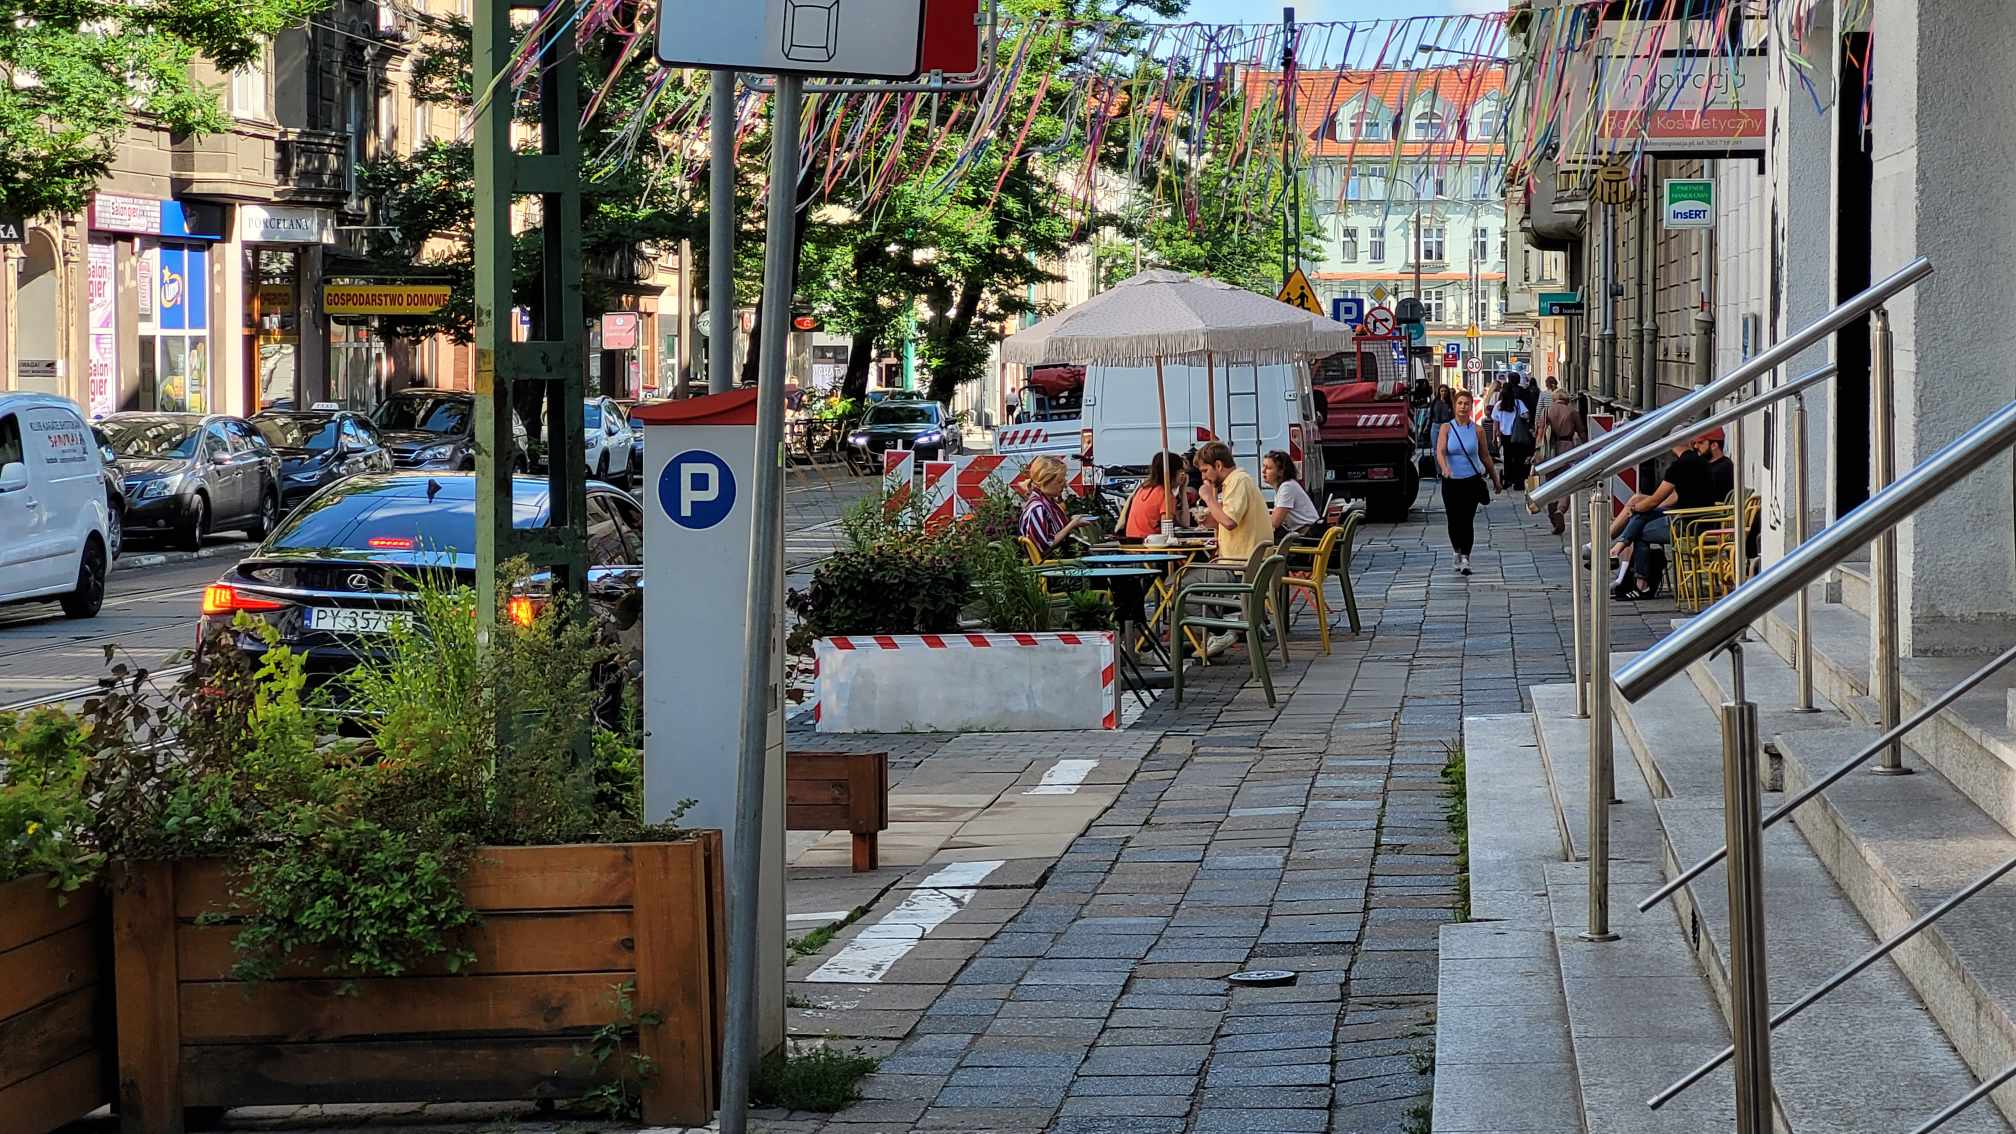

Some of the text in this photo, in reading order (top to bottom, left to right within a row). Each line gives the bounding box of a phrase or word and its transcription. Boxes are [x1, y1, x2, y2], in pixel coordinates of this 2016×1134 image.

[247, 216, 309, 230] PORCELANA
[1672, 209, 1708, 220] InsERT
[88, 259, 108, 280] Salon
[88, 279, 107, 304] gier
[326, 292, 405, 307] GOSPODARSTWO
[1339, 301, 1358, 326] P
[89, 359, 109, 377] Salon
[1468, 360, 1480, 370] 30
[89, 378, 108, 403] gier
[680, 462, 719, 517] P
[315, 609, 341, 629] PY
